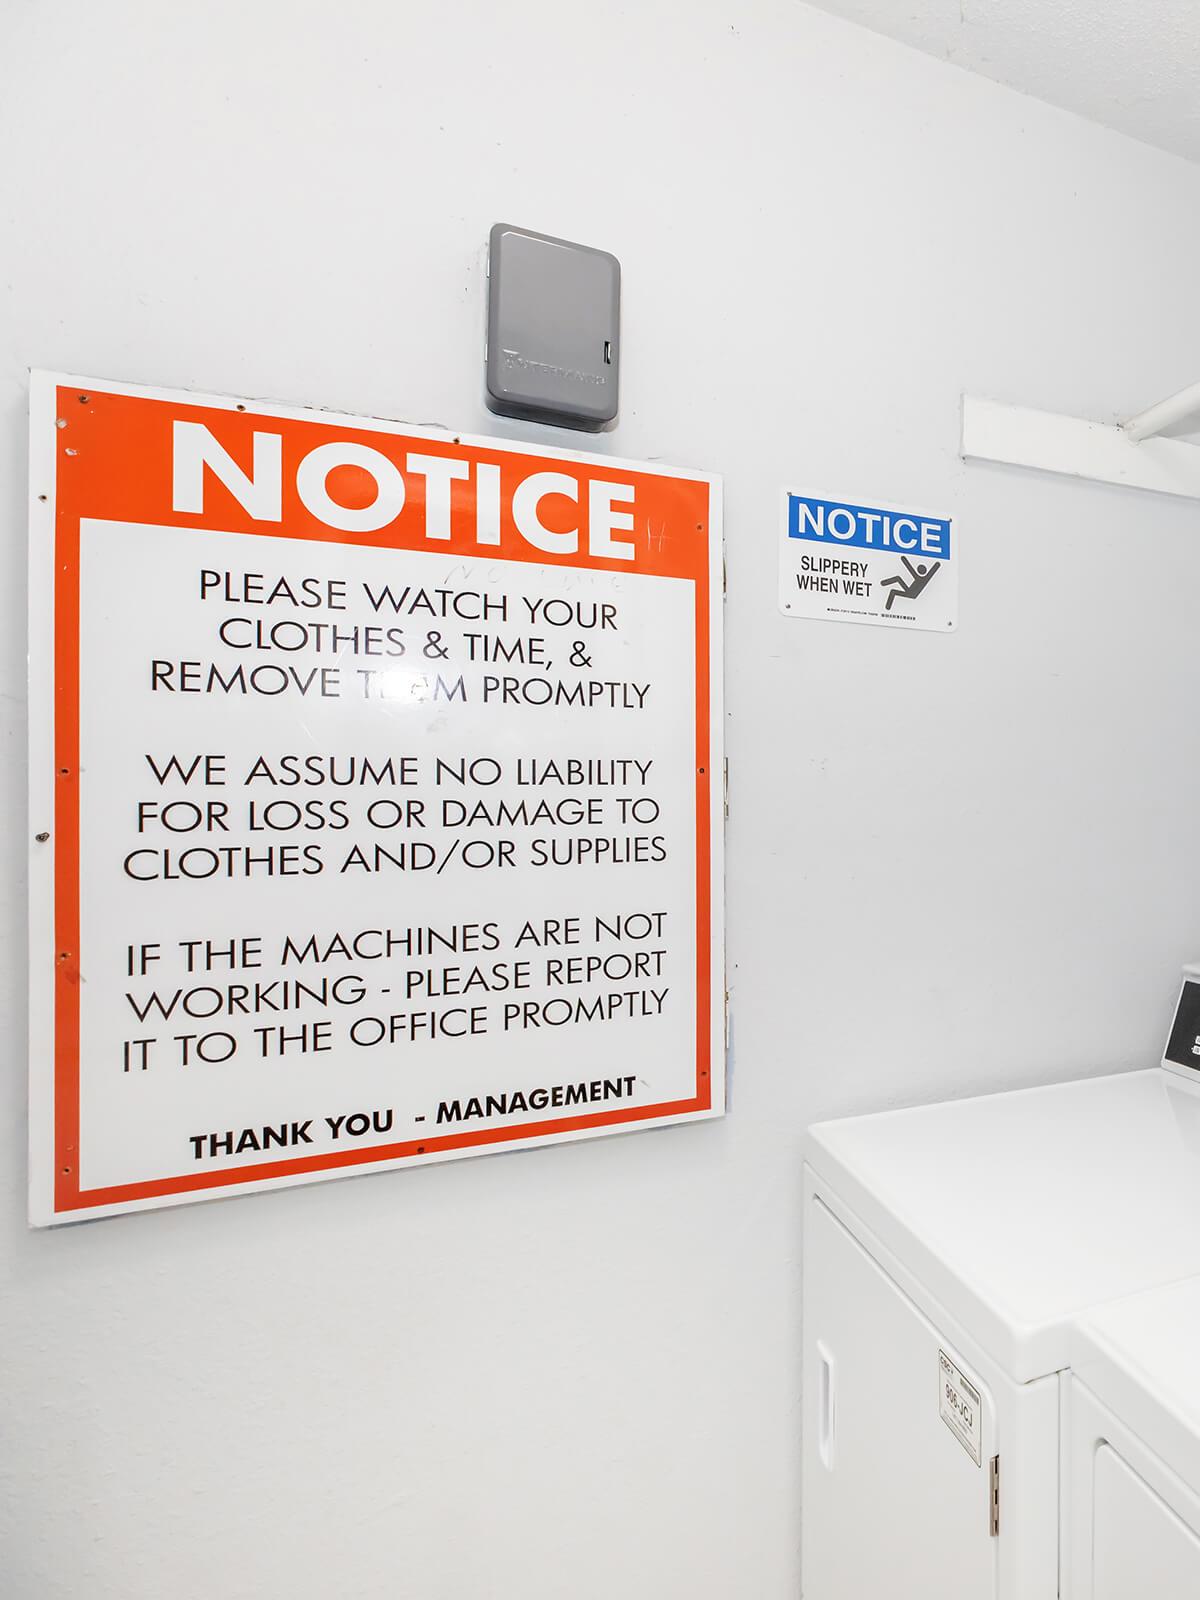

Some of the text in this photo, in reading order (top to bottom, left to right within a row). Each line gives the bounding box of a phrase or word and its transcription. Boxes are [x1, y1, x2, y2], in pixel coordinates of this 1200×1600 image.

[172, 419, 635, 561] NOTICE
[799, 503, 942, 553] NOTICE
[796, 574, 872, 597] WHEN WET
[801, 555, 869, 578] SLIPPERY
[200, 569, 618, 630] PLEASE WATCH YOUR
[218, 617, 593, 670] CLOTHES & TIME, &
[151, 660, 652, 710] REMOVE TM PROMPTLY
[145, 754, 652, 786] WE ASSUME NO LIABILITY
[137, 797, 660, 832] FOR LOSS OR DAMAGE TO
[123, 836, 667, 881] CLOTHES AND/OR SUPPLIES
[127, 912, 667, 976] IF THE MACHINES ARE NOT
[125, 974, 366, 1023] WORKING
[406, 961, 531, 999] PLEASE
[545, 950, 667, 987] REPORT
[123, 988, 670, 1072] IT TO THE OFFICE PROMPTLY
[189, 1116, 314, 1160] THANK
[325, 1109, 394, 1140] YOU
[436, 1076, 637, 1124] MANAGEMENT
